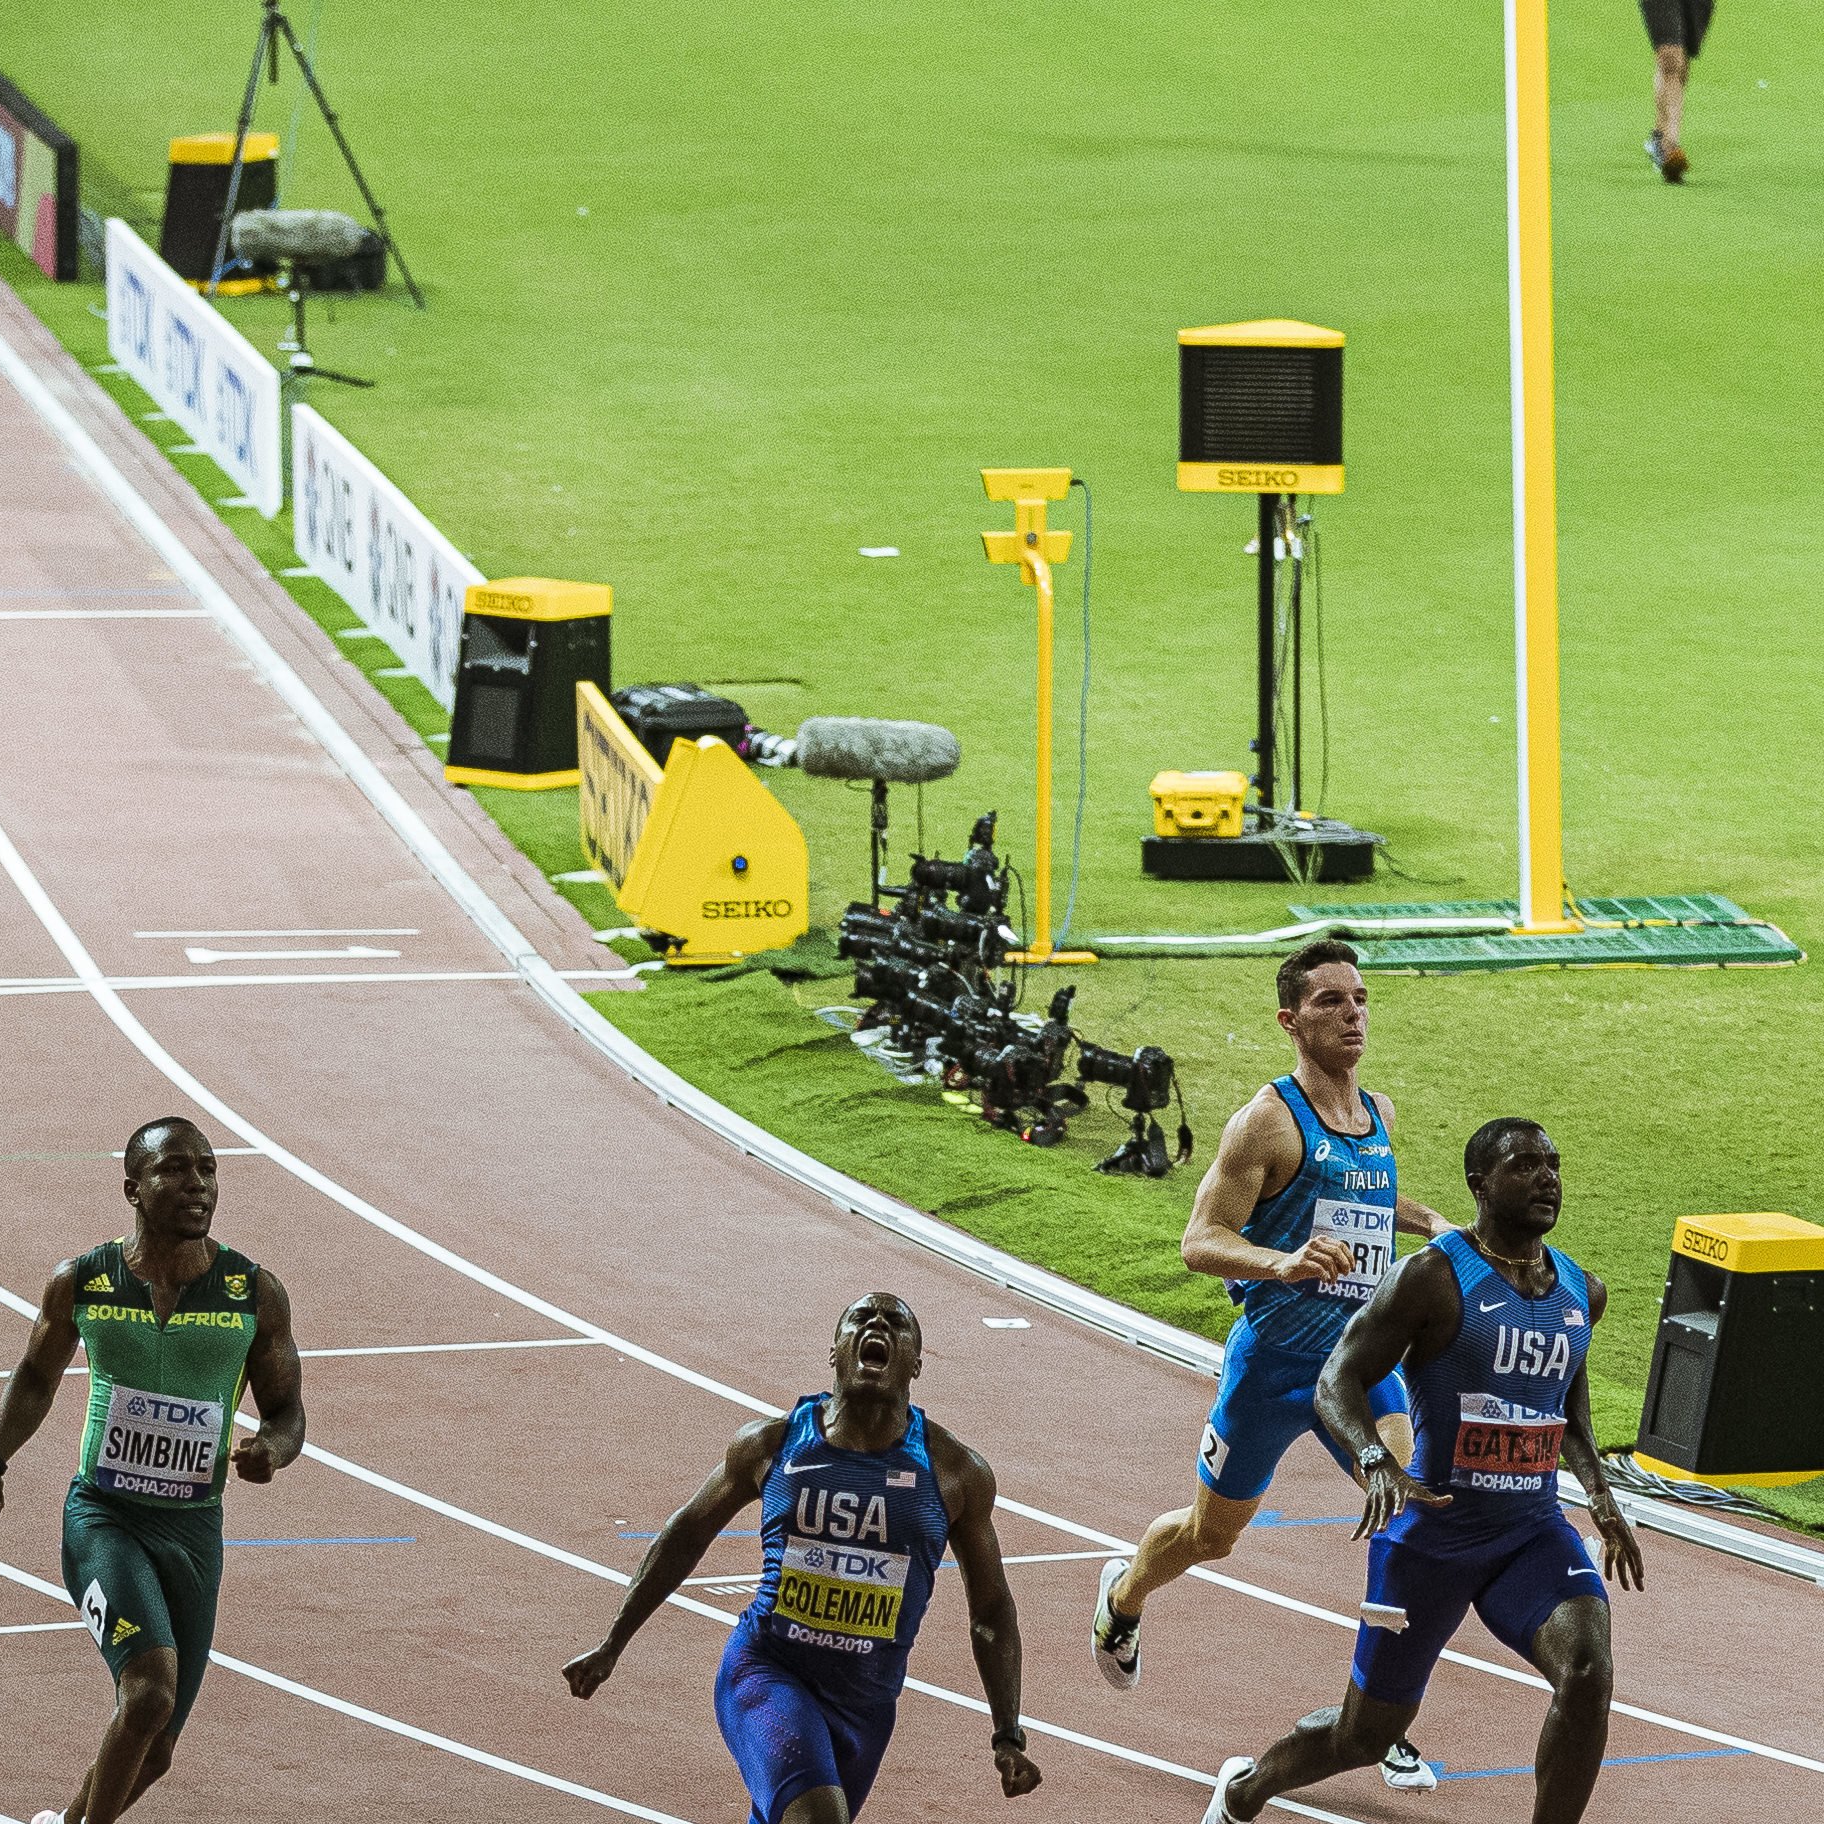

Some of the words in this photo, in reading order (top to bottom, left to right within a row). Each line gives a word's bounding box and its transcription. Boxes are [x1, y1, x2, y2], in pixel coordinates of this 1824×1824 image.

[1218, 469, 1299, 488] SEIKO
[475, 591, 534, 615] SEIKO
[701, 899, 793, 919] SEIKO
[1343, 1170, 1390, 1191] ITALIA
[1349, 1208, 1391, 1232] TDK
[1682, 1228, 1729, 1262] SEIKO
[86, 1304, 156, 1325] SOUTH
[167, 1311, 244, 1330] AFRICA
[1493, 1325, 1570, 1381] USA
[148, 1398, 211, 1428] TDK
[105, 1425, 213, 1474] SIMBINE
[1203, 1432, 1218, 1469] 2
[113, 1472, 194, 1499] DOHA2019
[796, 1487, 888, 1543] USA
[826, 1550, 893, 1580] TDK
[86, 1594, 103, 1632] 5
[781, 1575, 896, 1628] COLEMAN
[787, 1623, 874, 1654] DOHA2019
